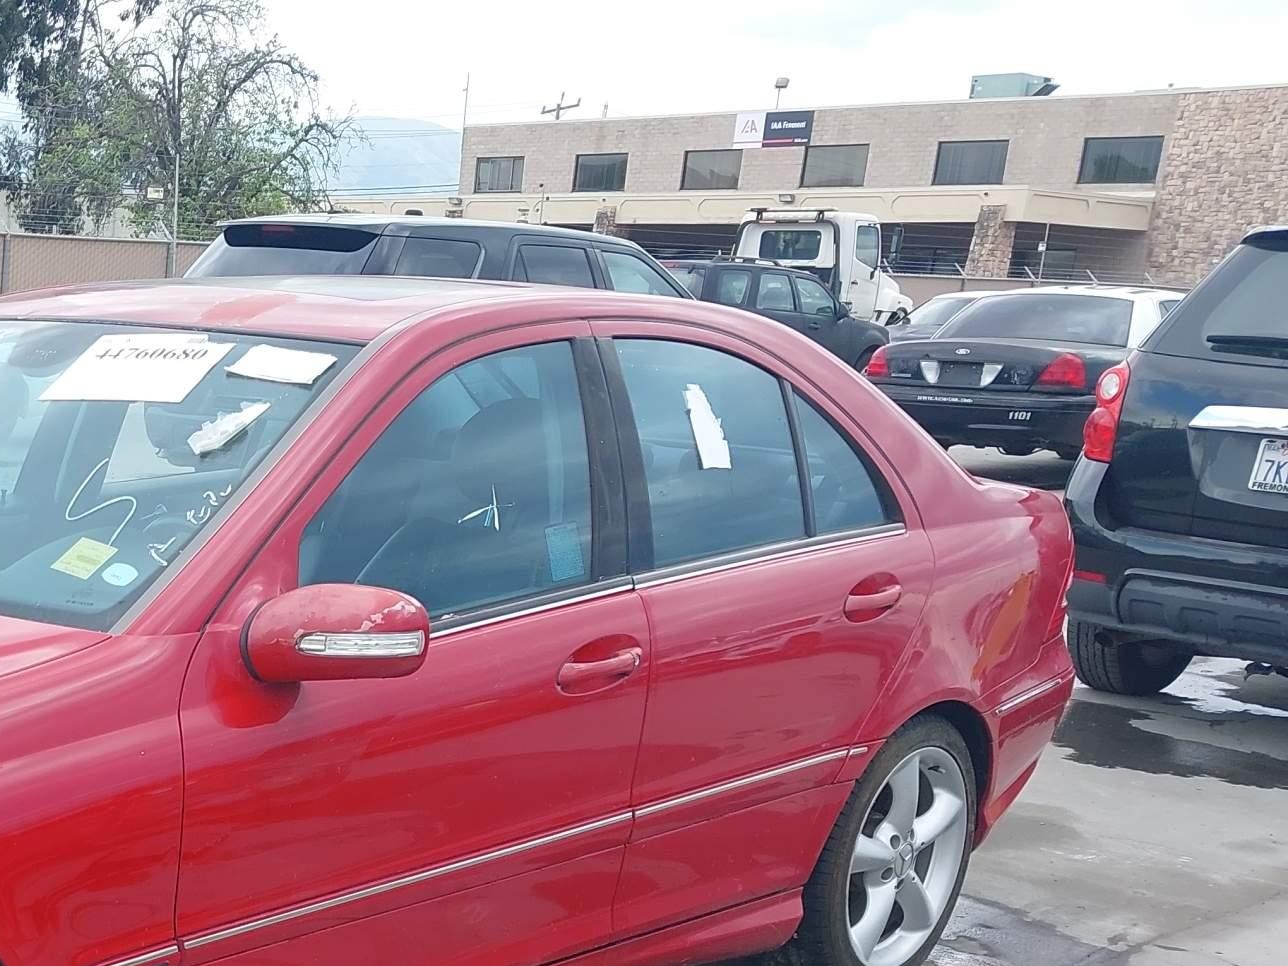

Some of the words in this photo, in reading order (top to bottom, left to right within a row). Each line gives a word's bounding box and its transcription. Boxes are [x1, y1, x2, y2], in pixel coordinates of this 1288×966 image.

[95, 347, 209, 360] 44760680
[1008, 411, 1032, 421] 1101
[1263, 459, 1288, 483] 7K
